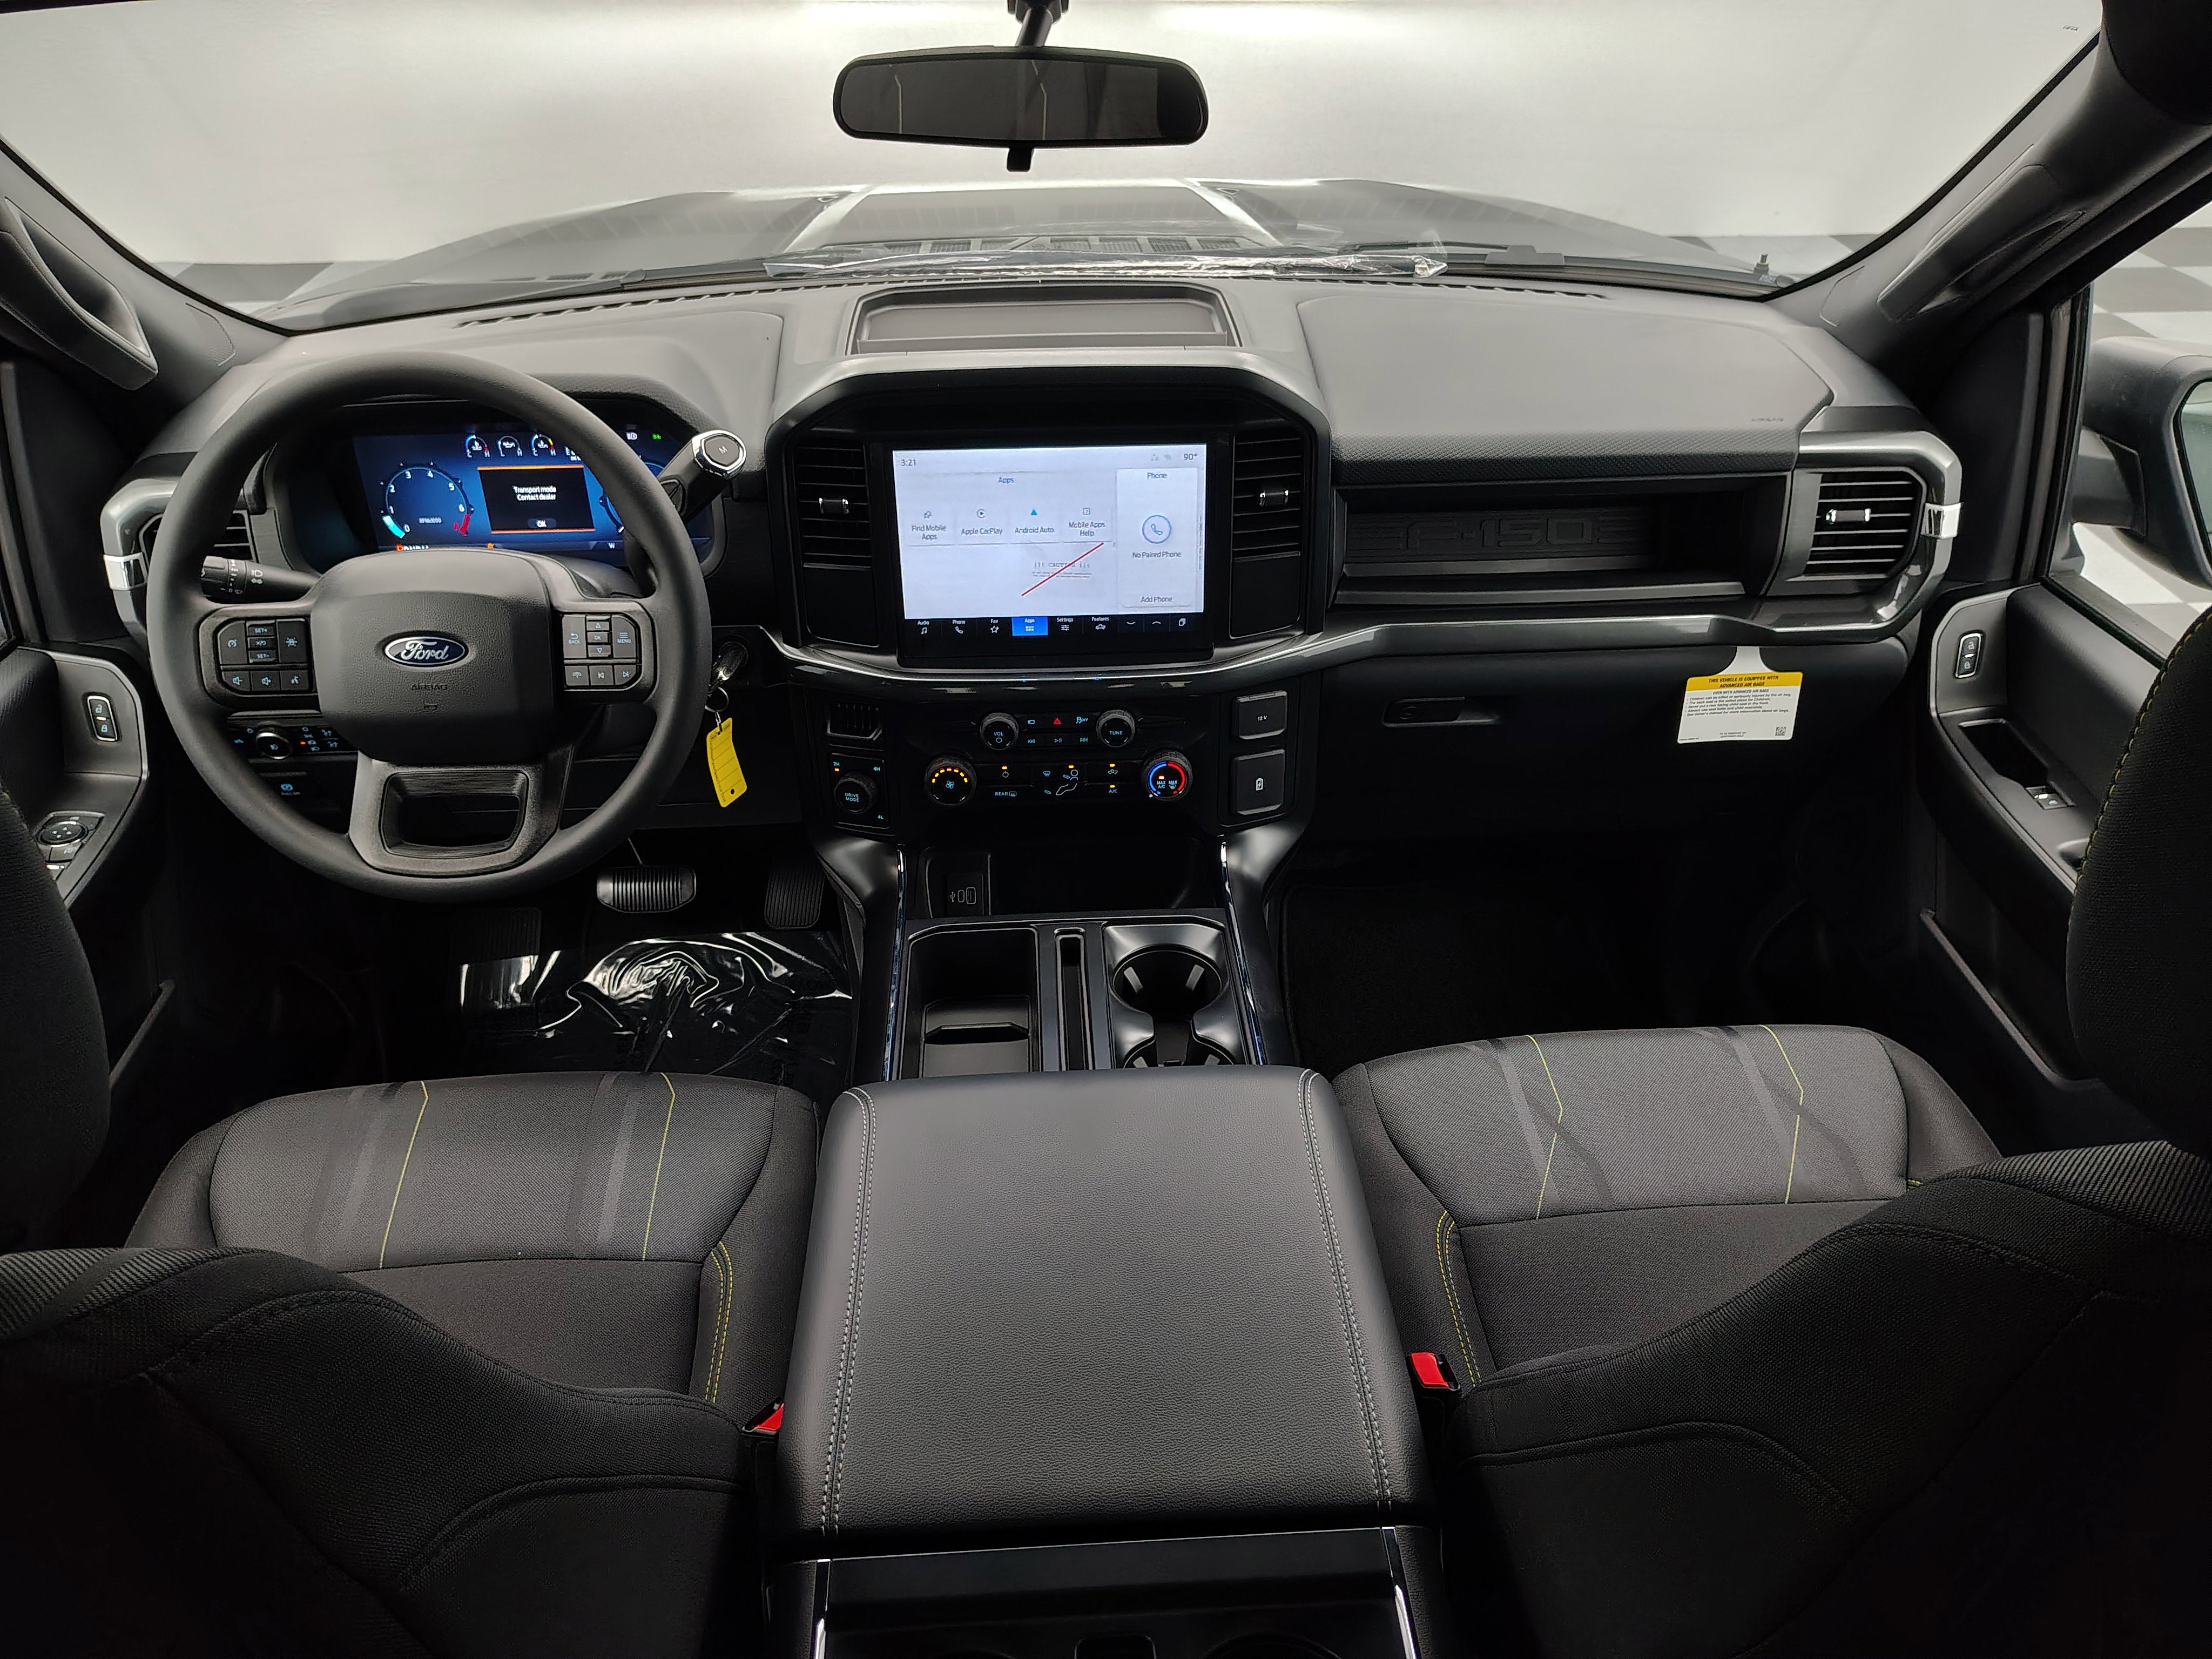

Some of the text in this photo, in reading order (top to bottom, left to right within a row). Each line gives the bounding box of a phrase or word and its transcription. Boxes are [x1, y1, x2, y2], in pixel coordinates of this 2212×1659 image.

[718, 446, 727, 454] M
[406, 470, 412, 479] 3
[428, 470, 434, 478] 4
[390, 485, 396, 493] 2
[449, 483, 455, 491] 5
[514, 485, 540, 494] Transport
[458, 504, 464, 512] 6
[404, 524, 410, 532] 0
[401, 641, 449, 660] Ford
